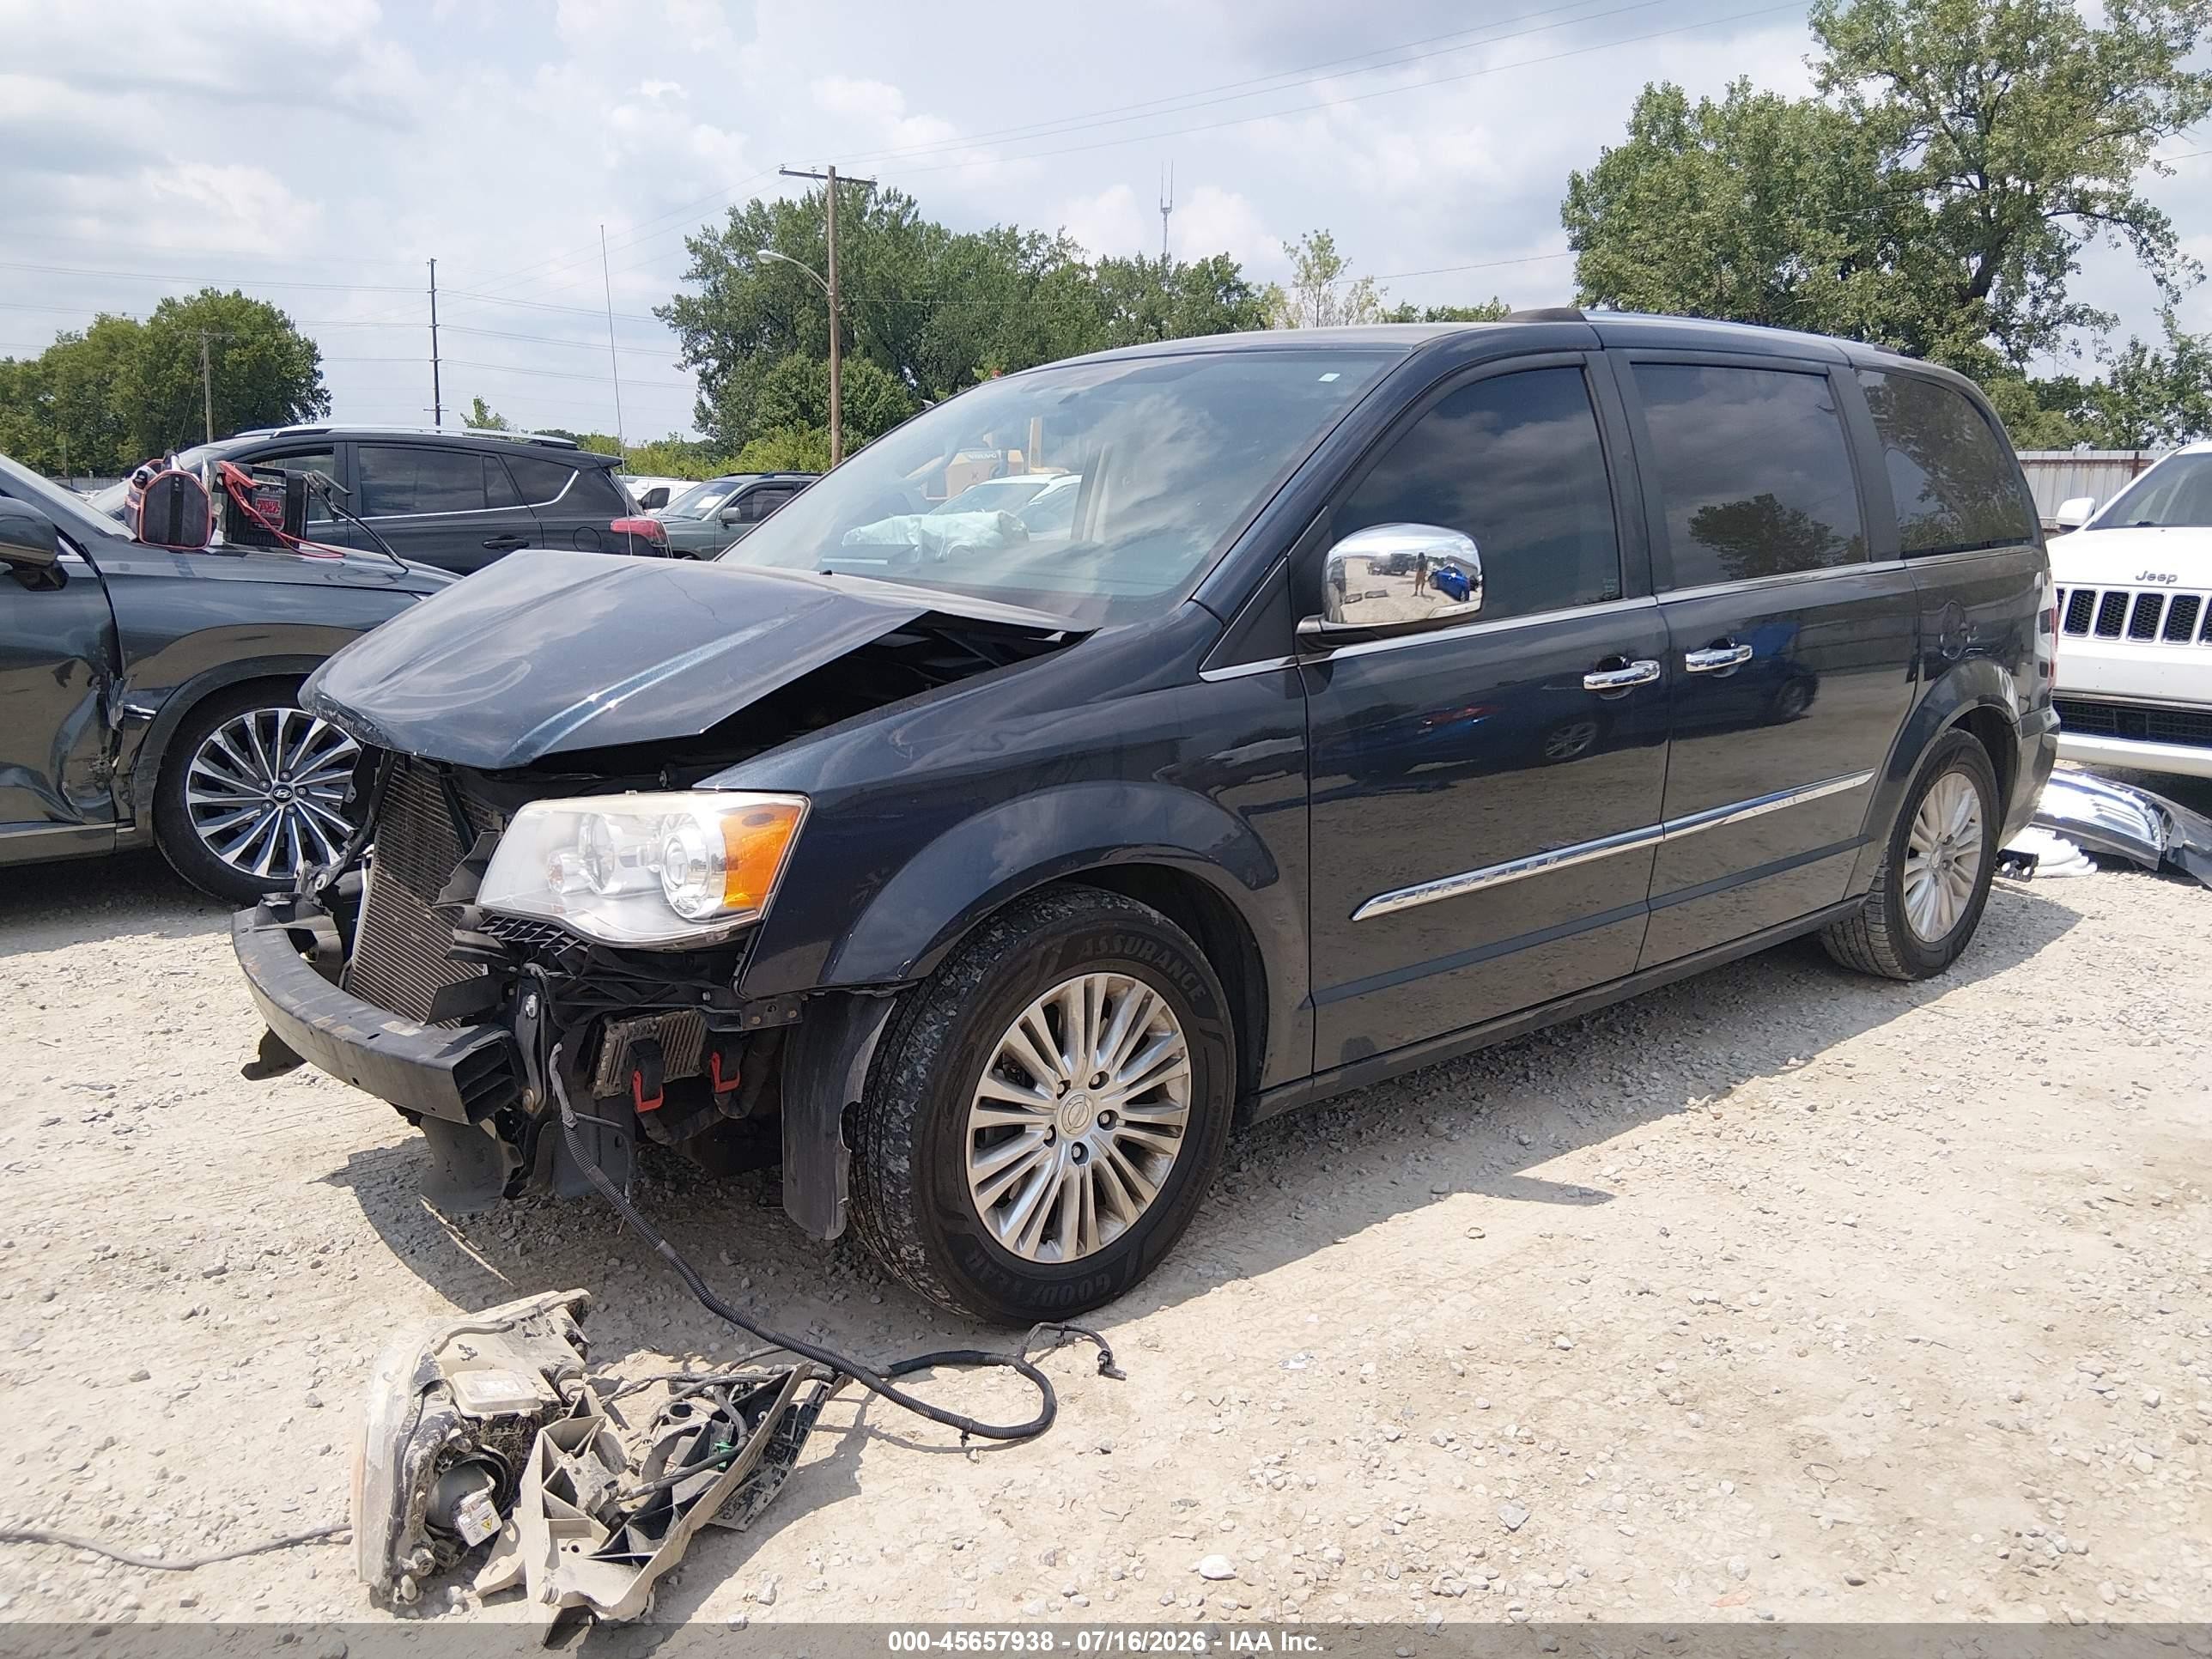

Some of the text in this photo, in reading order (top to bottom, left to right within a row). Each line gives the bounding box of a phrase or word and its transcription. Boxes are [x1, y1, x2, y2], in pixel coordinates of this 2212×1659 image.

[2135, 570, 2179, 585] Jeep
[1391, 855, 1559, 905] CHRYSLER
[1079, 933, 1206, 1002] ASSURANCE
